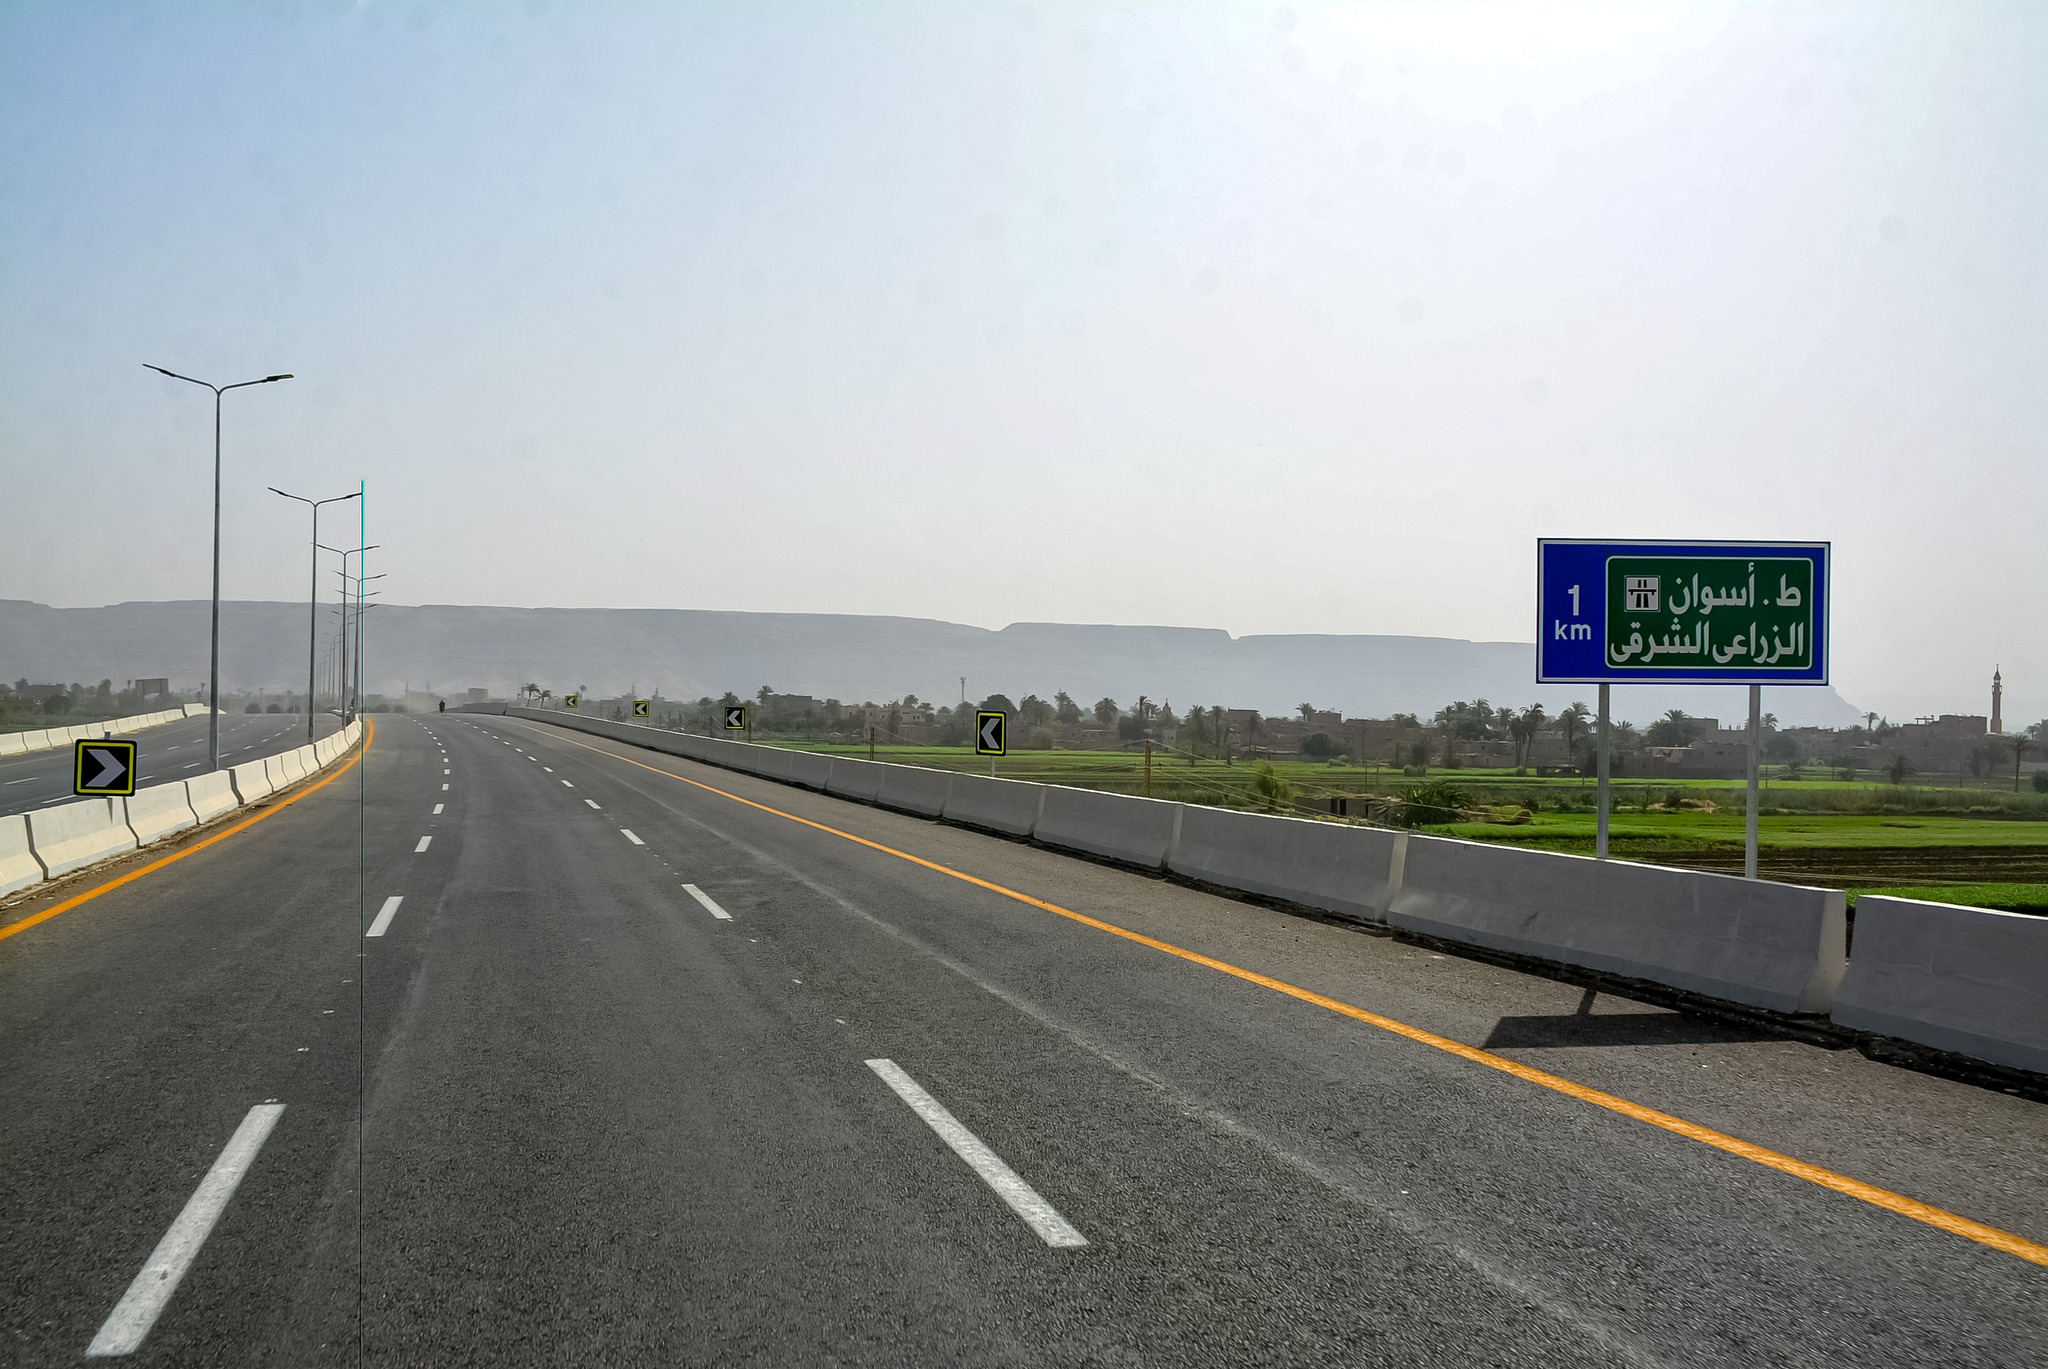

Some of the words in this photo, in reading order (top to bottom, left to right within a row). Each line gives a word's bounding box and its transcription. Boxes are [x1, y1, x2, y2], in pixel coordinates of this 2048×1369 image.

[1568, 585, 1579, 615] 1
[1668, 562, 1755, 614] أسوان
[1555, 620, 1591, 640] km
